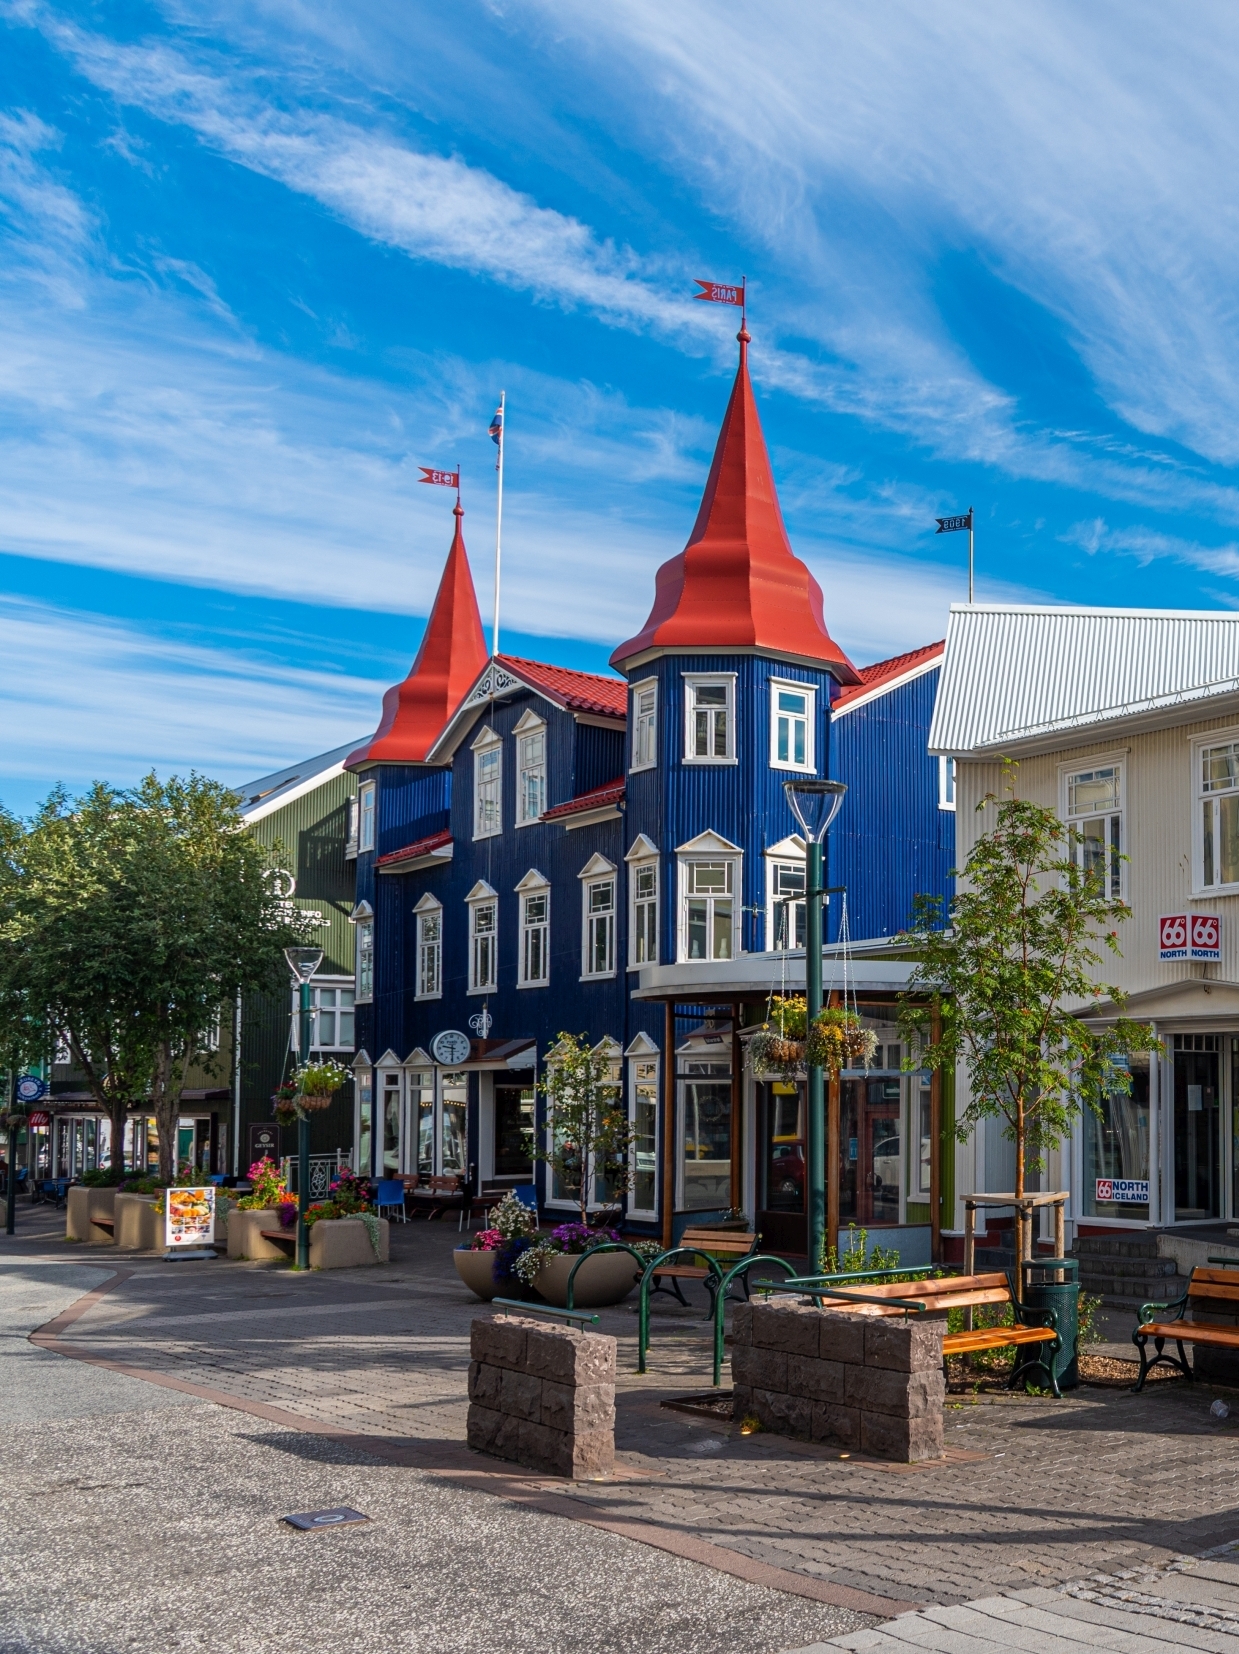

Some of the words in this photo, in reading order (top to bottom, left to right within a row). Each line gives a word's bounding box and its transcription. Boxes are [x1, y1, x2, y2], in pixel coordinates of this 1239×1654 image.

[1160, 949, 1187, 959] NORTH
[1191, 949, 1219, 958] NORTH
[31, 1113, 49, 1125] illy
[1112, 1180, 1148, 1192] NORTH
[1112, 1192, 1148, 1201] ICELAND
